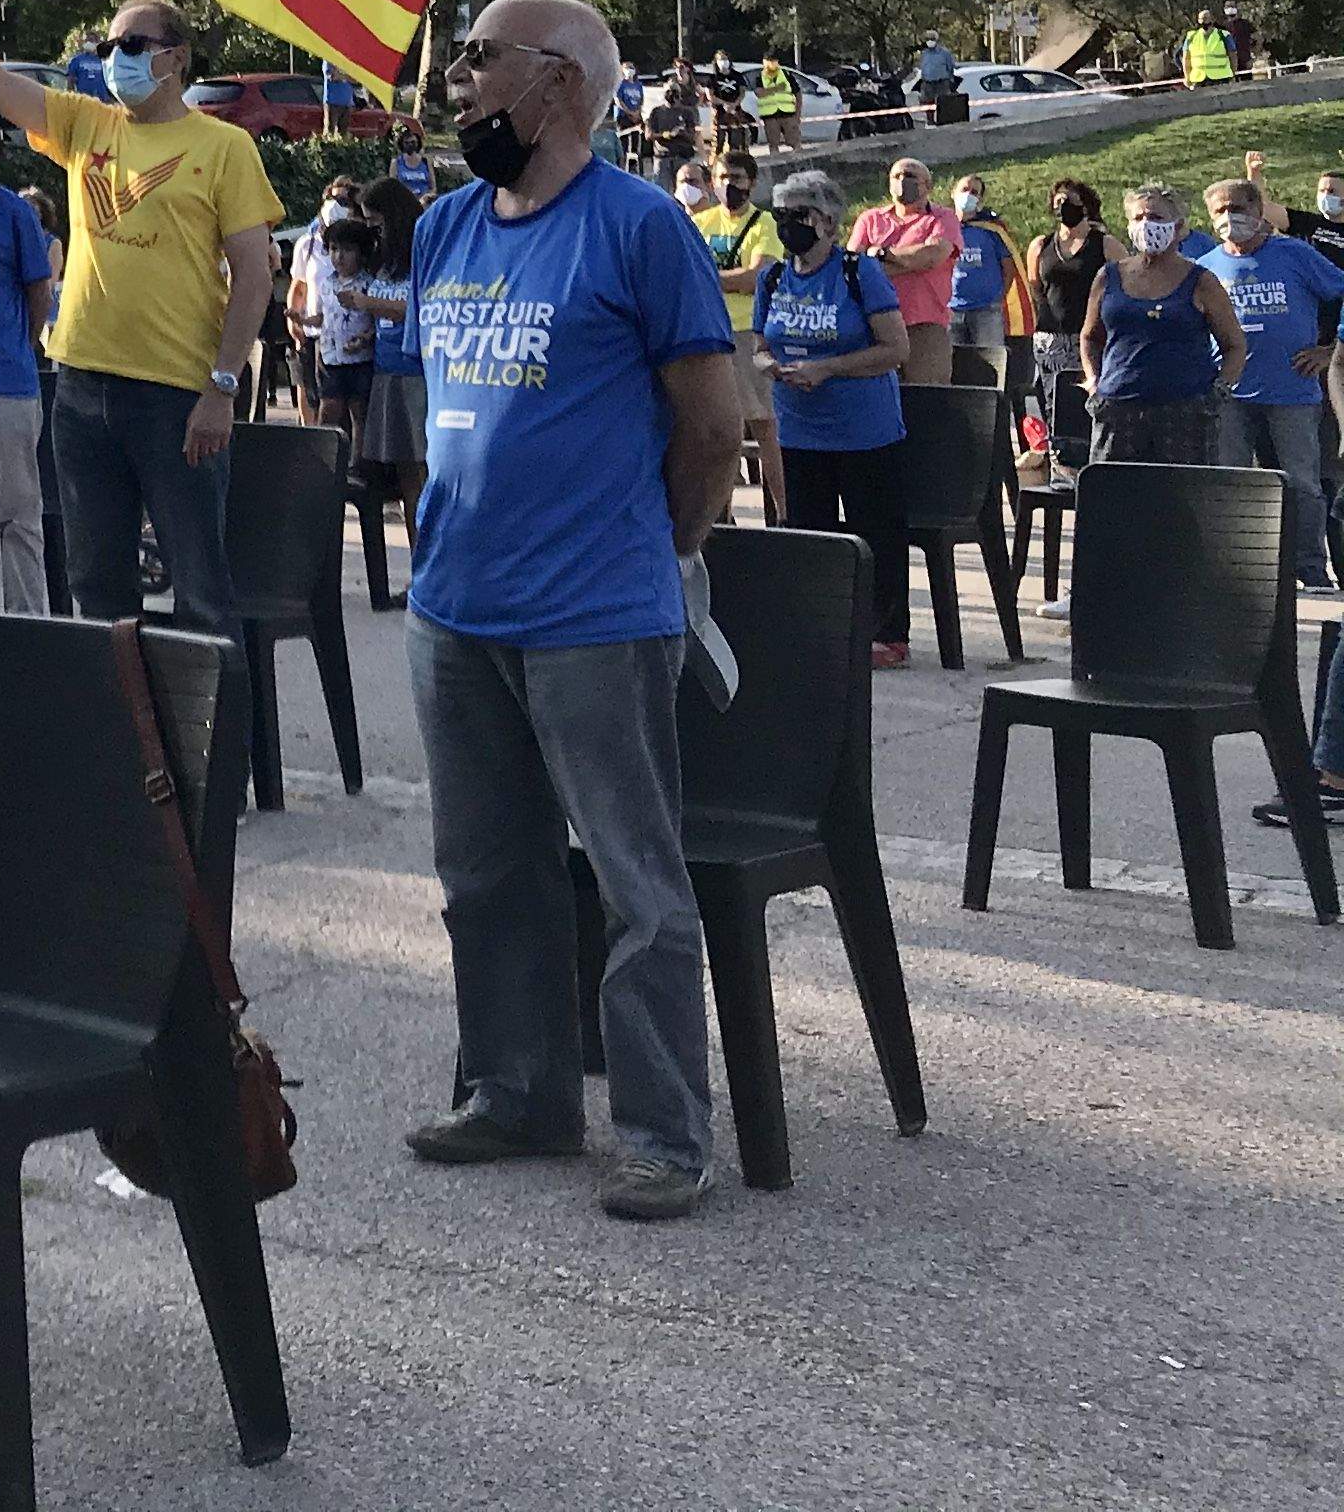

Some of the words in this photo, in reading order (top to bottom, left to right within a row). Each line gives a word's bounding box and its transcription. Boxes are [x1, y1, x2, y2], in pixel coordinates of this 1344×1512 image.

[1227, 282, 1287, 295] NSTRUIR
[419, 301, 555, 327] CONSTRUIR
[773, 311, 837, 330] FUTUR
[428, 326, 550, 365] FUTUR
[447, 361, 547, 391] MILLOR
